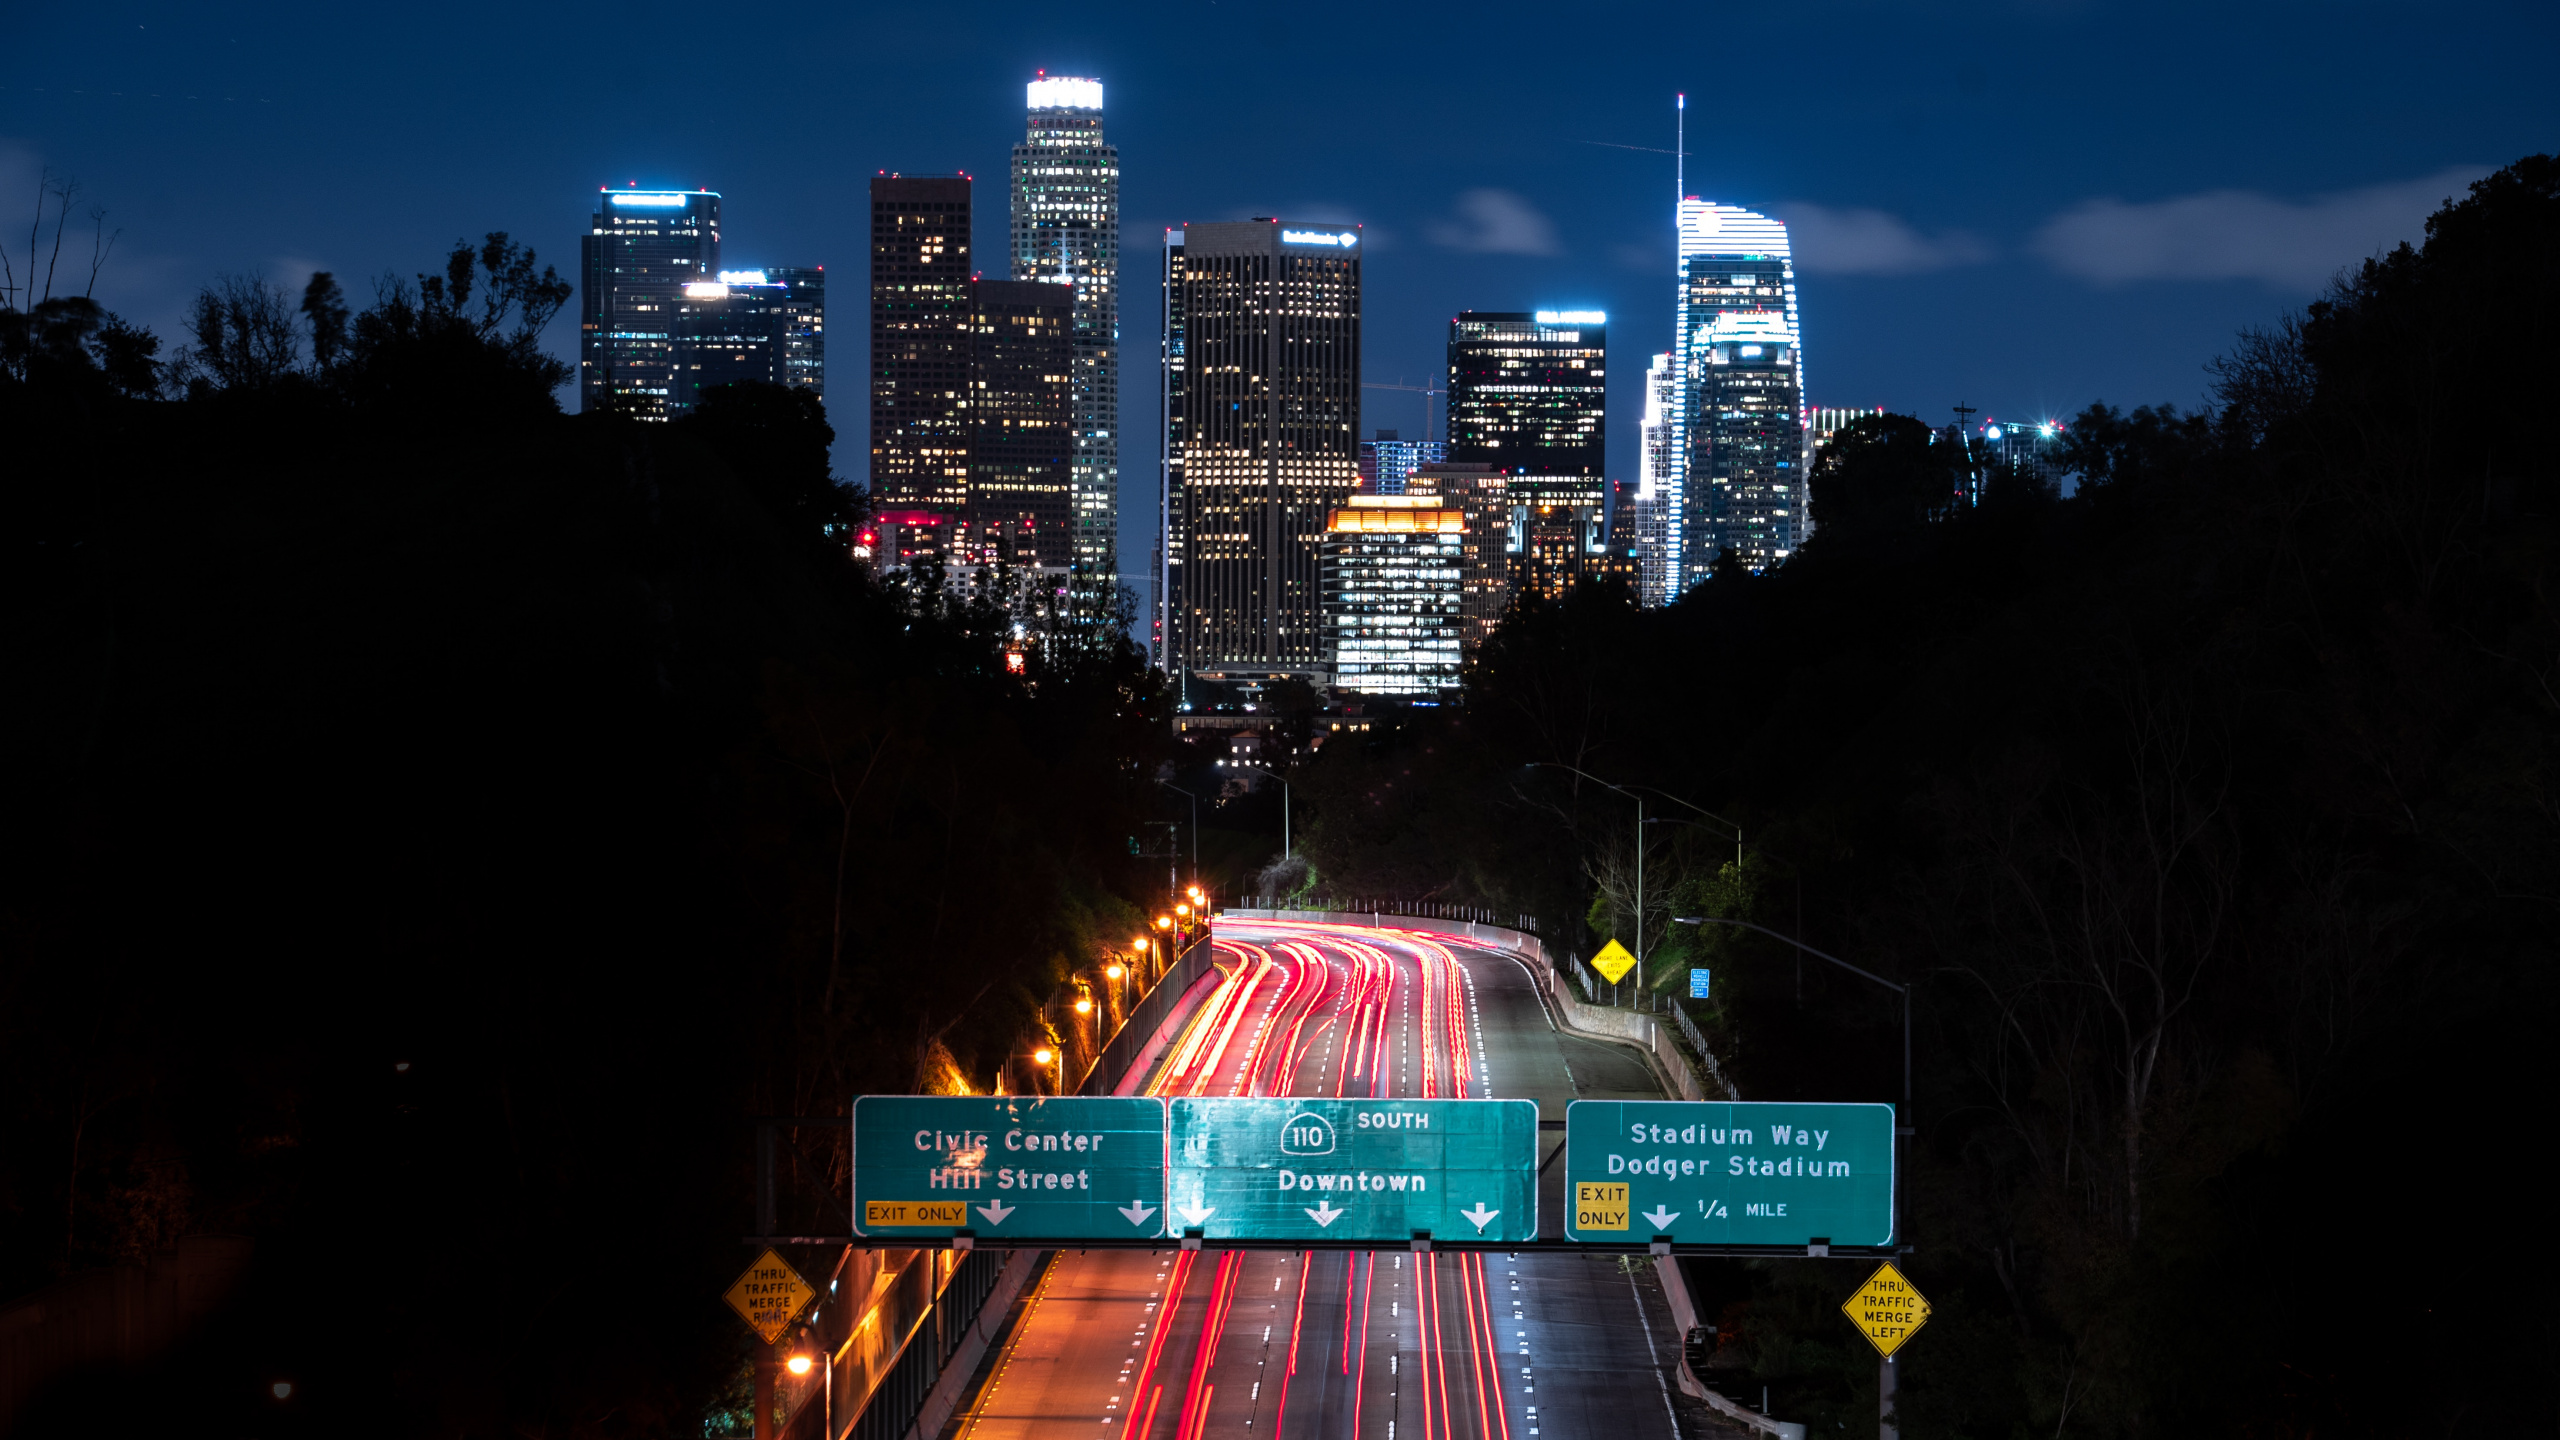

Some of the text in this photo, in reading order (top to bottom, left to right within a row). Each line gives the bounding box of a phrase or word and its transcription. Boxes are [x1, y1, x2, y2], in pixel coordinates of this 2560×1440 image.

[1357, 1112, 1429, 1129] SOUTH
[914, 1130, 1104, 1152] Civic Center
[1293, 1126, 1323, 1147] 110
[1631, 1123, 1829, 1151] Stadium Way
[1608, 1154, 1850, 1181] Dodger Stadium
[929, 1168, 1089, 1190] Hill Street
[1278, 1169, 1426, 1192] Downtown
[1581, 1187, 1625, 1201] EXIT
[868, 1207, 964, 1221] EXIT ONLY
[1746, 1203, 1788, 1217] MILE
[1579, 1211, 1626, 1226] ONLY
[753, 1268, 787, 1280] THRU
[744, 1282, 797, 1295] TRAFFIC
[1872, 1280, 1905, 1293] THRU
[749, 1296, 791, 1309] MERGE
[1862, 1295, 1915, 1308] TRAFFIC
[1864, 1310, 1913, 1324] MERGE
[1871, 1326, 1906, 1338] LEFT
